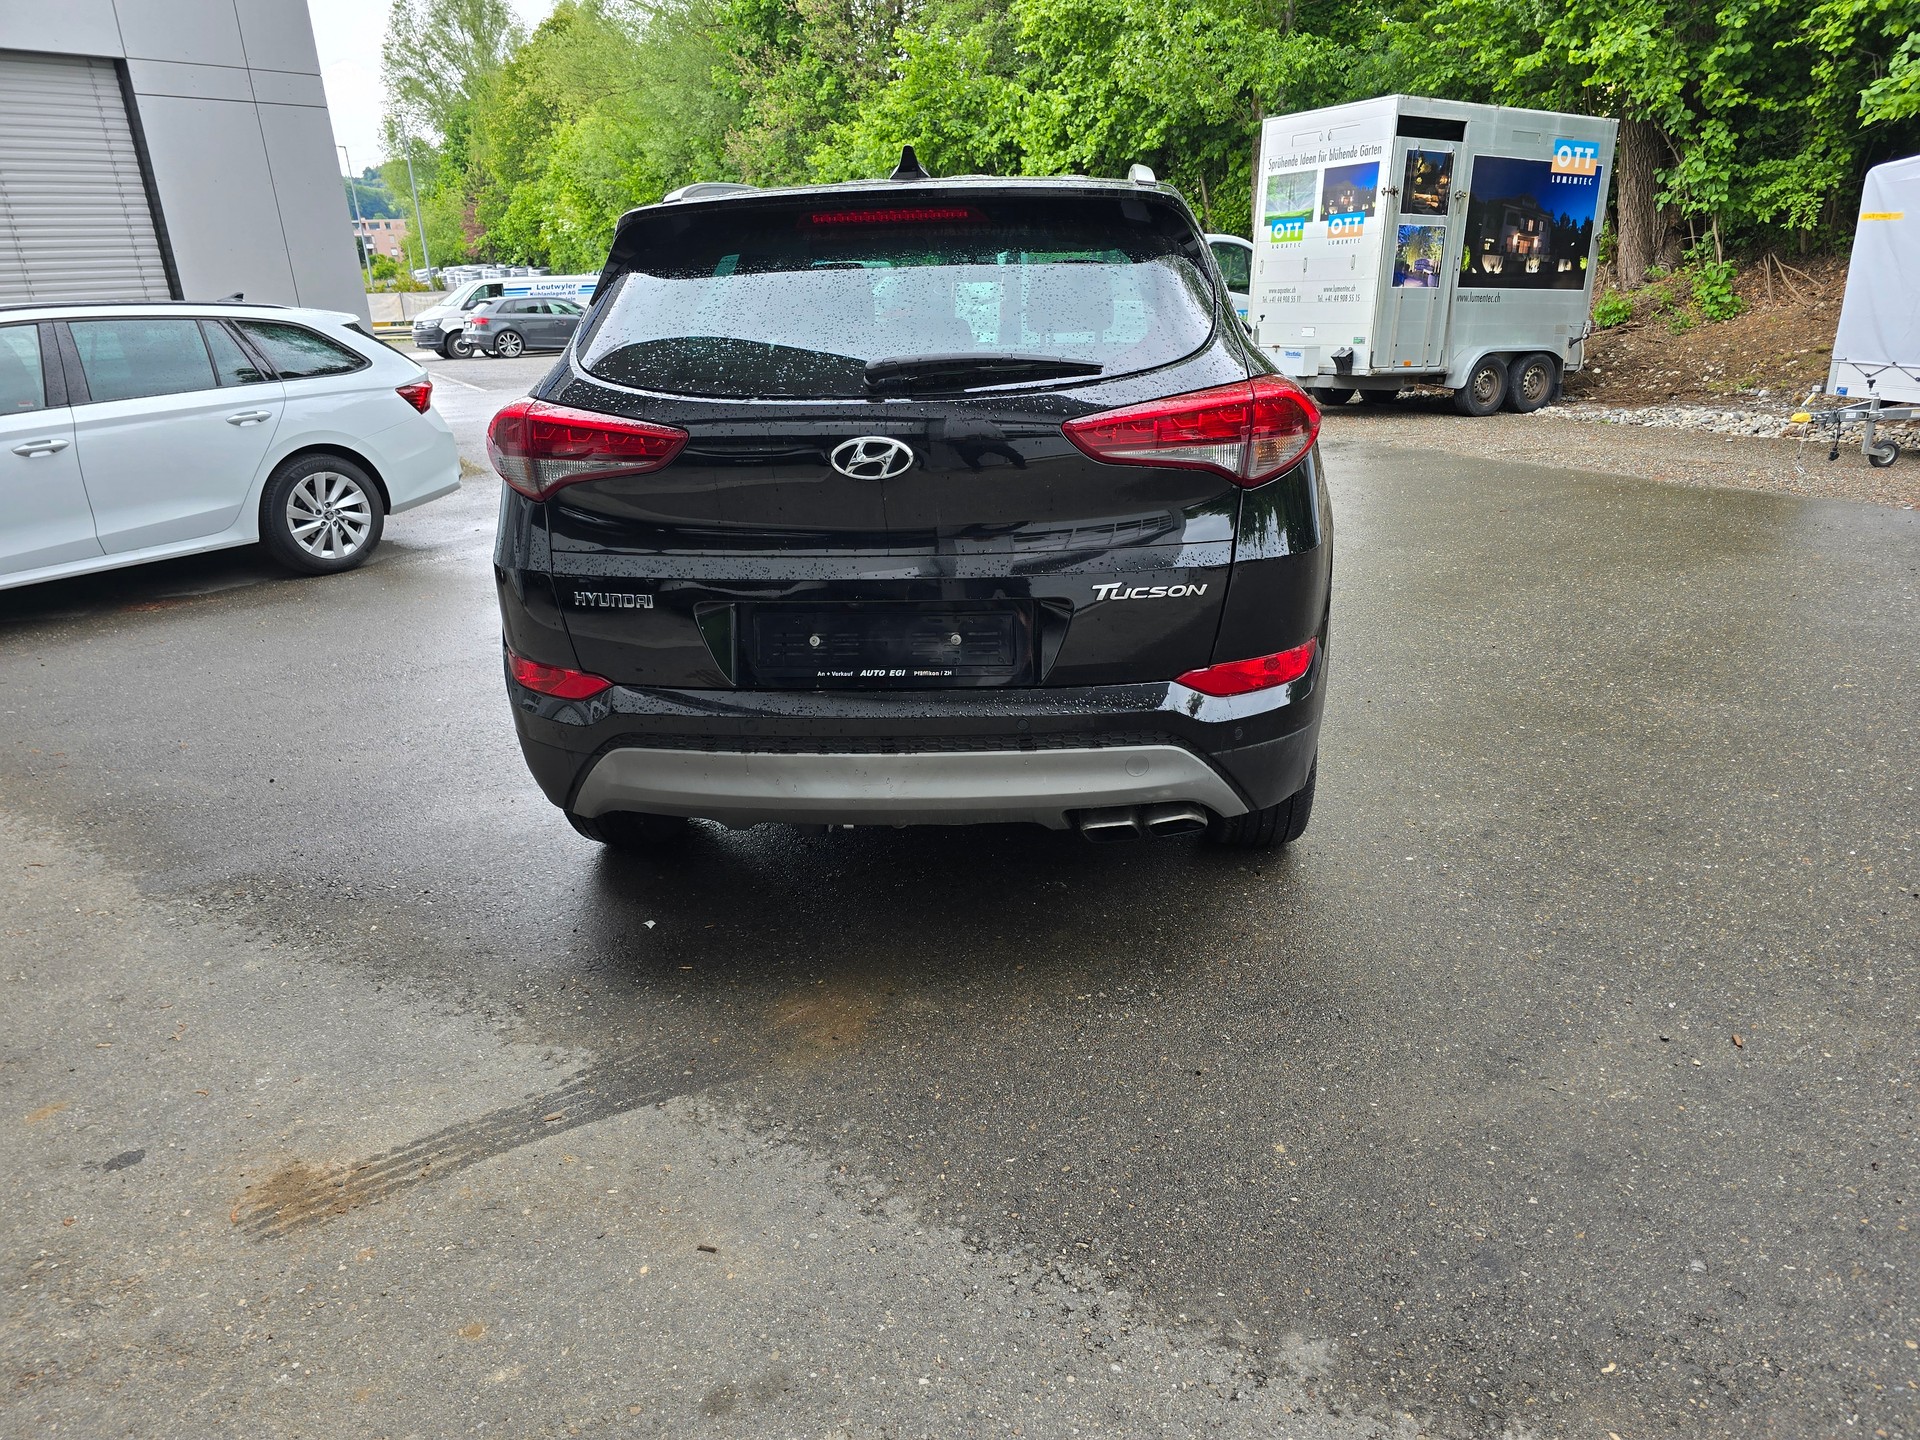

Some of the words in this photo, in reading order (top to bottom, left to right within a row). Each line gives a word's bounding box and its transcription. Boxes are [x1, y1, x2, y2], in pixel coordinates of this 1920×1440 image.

[1268, 154, 1299, 172] Sprühende
[1300, 152, 1317, 165] Ideen
[1318, 150, 1327, 163] für
[1329, 145, 1358, 161] blühende
[1360, 144, 1382, 157] Gärten
[1557, 145, 1594, 169] OTT
[1551, 175, 1593, 186] LUMENTEC
[1273, 222, 1302, 239] OTT
[1330, 217, 1361, 235] OTT
[1328, 238, 1361, 246] LUMENTEC
[573, 591, 654, 609] HYUNDAI
[1091, 581, 1208, 601] TUCSON
